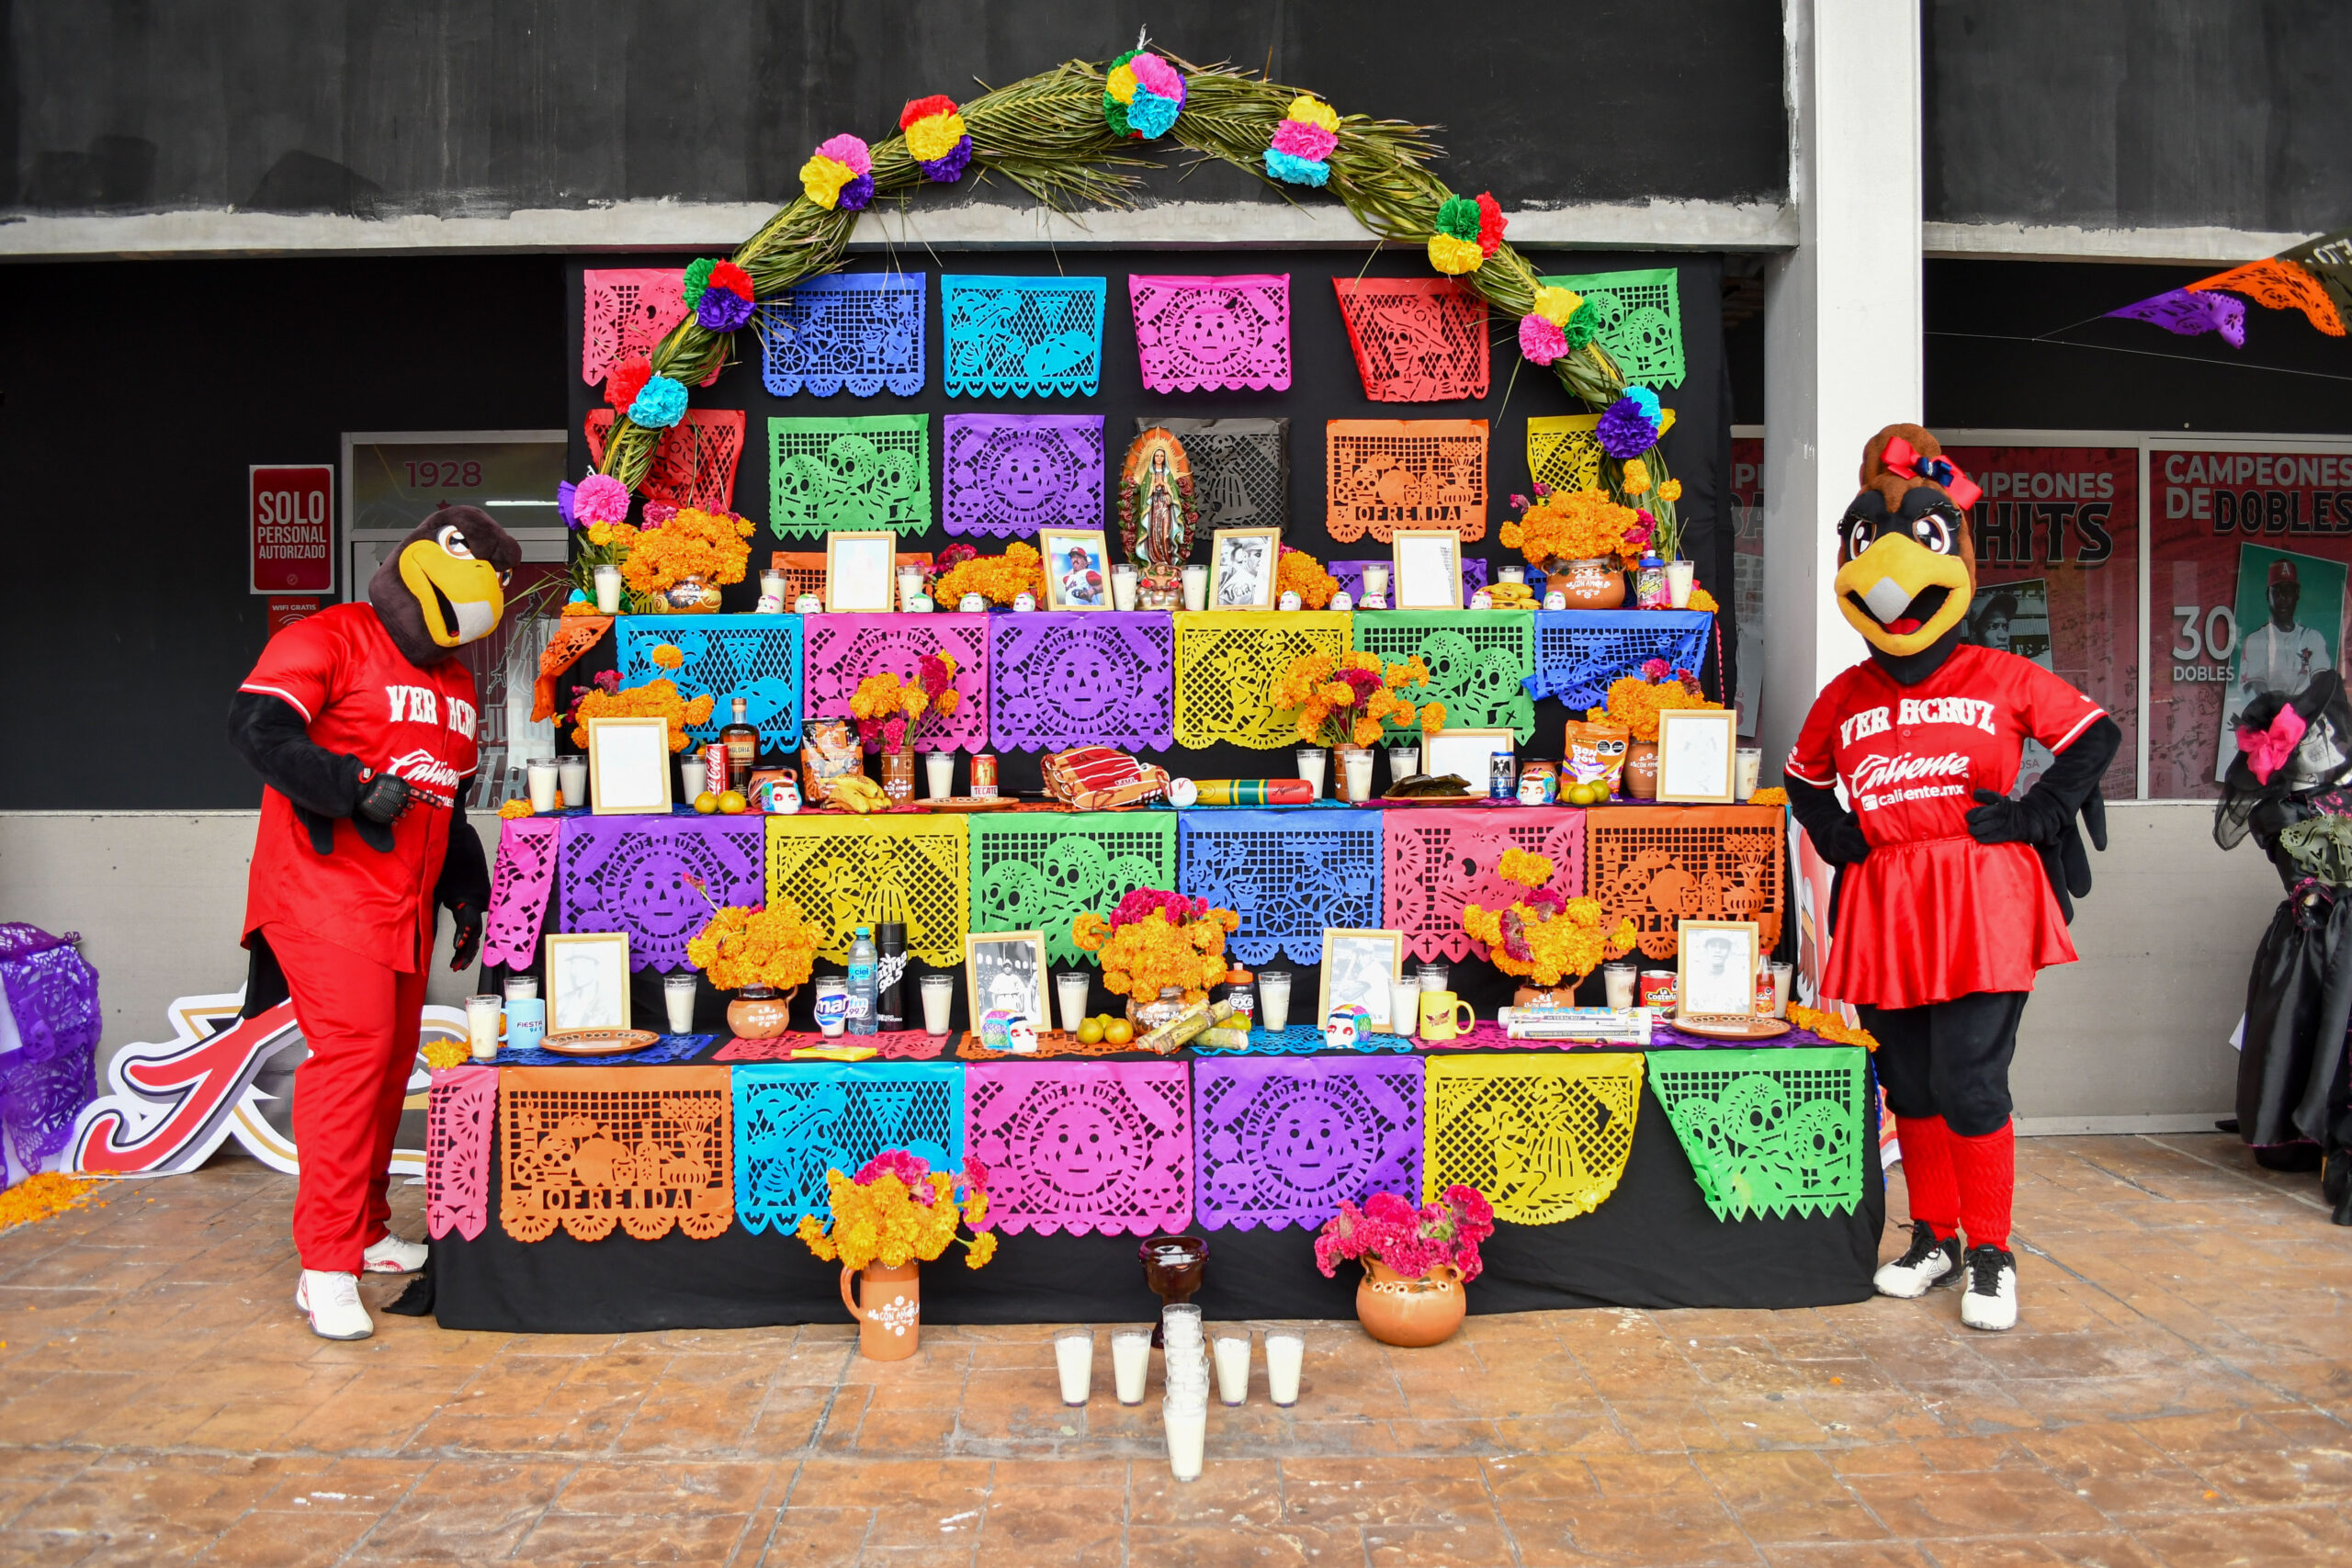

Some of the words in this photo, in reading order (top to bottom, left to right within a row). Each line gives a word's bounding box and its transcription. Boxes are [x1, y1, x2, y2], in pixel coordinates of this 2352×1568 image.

[404, 461, 482, 488] 1928
[2165, 454, 2352, 488] CAMPEONES
[1964, 472, 2113, 498] MPEONES
[258, 491, 325, 525] SOLO
[1358, 506, 1461, 521] OFRENDA
[2166, 487, 2211, 520] DE
[2213, 489, 2352, 536] DOBLES
[257, 526, 327, 544] PERSONAL
[1973, 502, 2113, 563] HITS
[258, 545, 326, 559] AUTORIZADO
[2172, 604, 2236, 660] 30
[2173, 665, 2235, 682] DOBLES
[1848, 751, 1970, 799] Caliente
[974, 786, 997, 795] TECATE
[1878, 784, 1965, 807] caliente.mx
[854, 967, 869, 976] ciel
[849, 1007, 866, 1015] 99.7
[546, 1189, 692, 1211] OFRENDA
